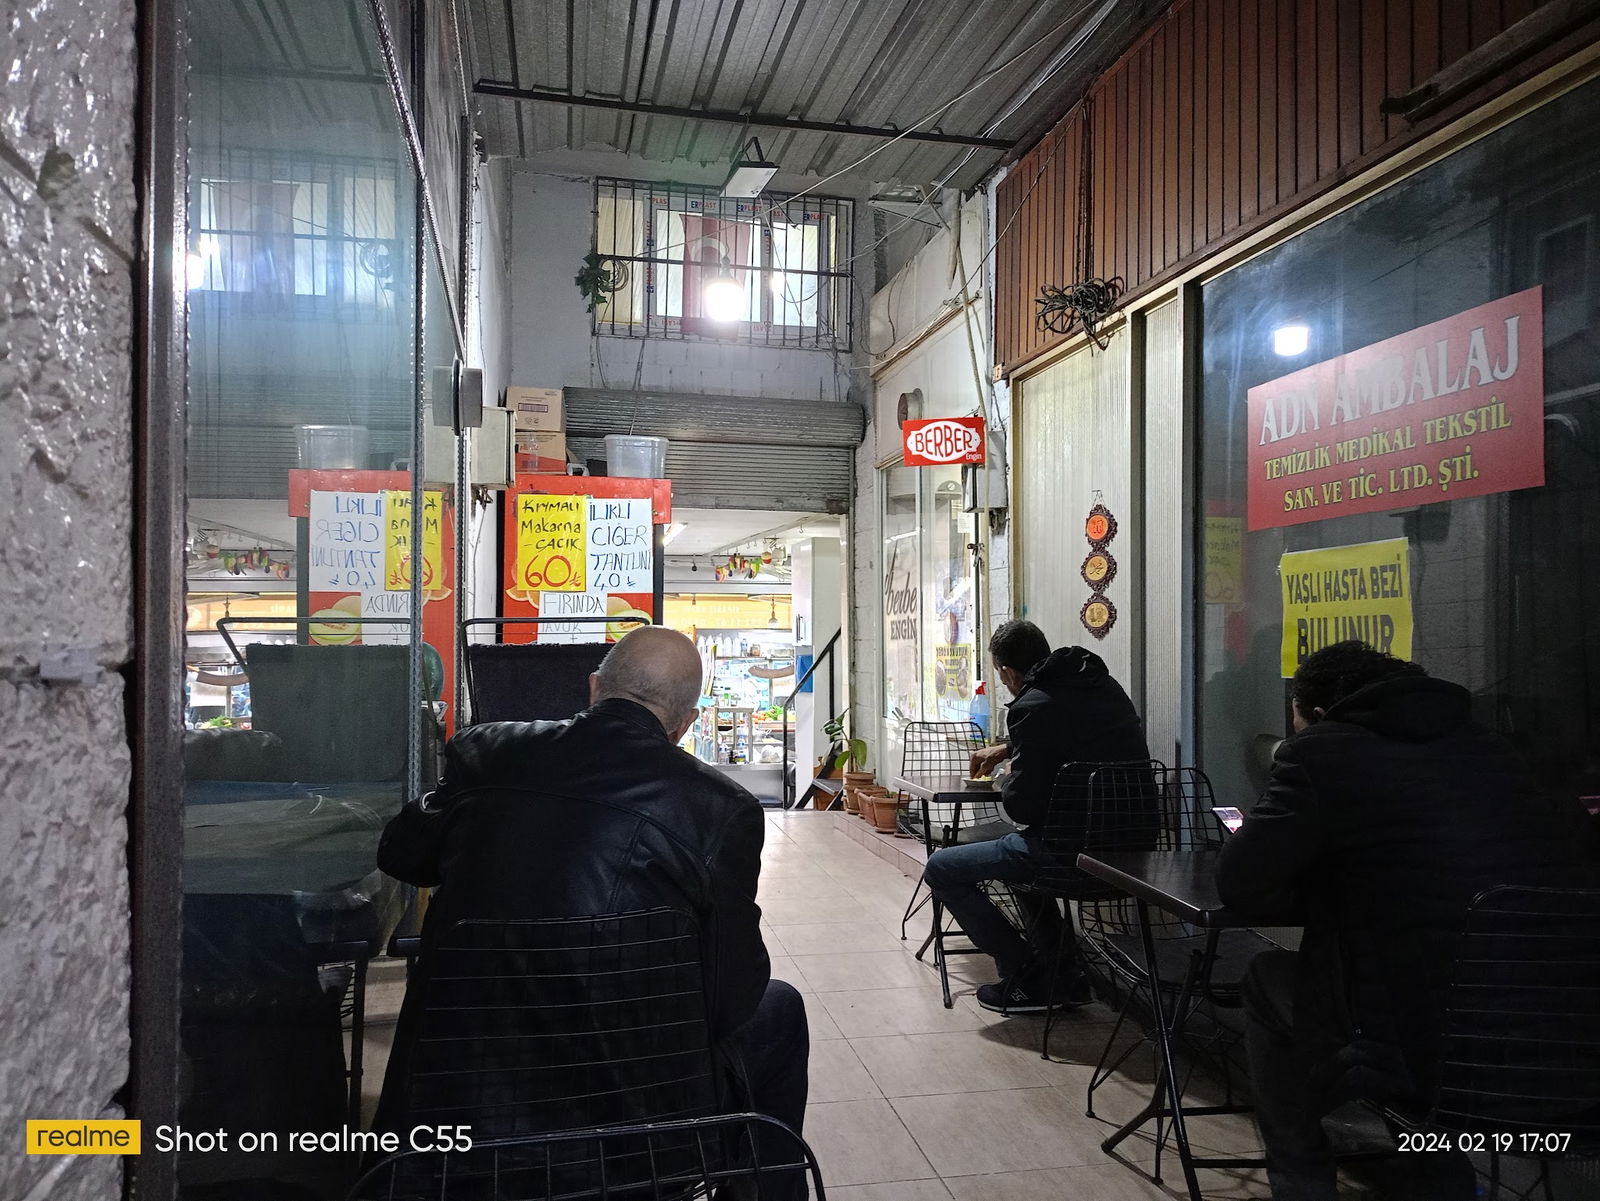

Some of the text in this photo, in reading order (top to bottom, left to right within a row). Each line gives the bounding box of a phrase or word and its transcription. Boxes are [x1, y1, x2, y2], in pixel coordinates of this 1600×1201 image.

[1258, 316, 1520, 446] ADN AMBALAJ
[915, 424, 972, 458] BERBER
[1264, 396, 1512, 480] TEMİZLİK MEDİKAL TEKSTİL
[1284, 445, 1480, 512] SAN. VE TİC. LTD. ŞTİ.
[521, 517, 581, 536] Makarna
[543, 593, 605, 614] FIRINDA
[1286, 553, 1403, 612] YAŞLI HASTA BEZİ
